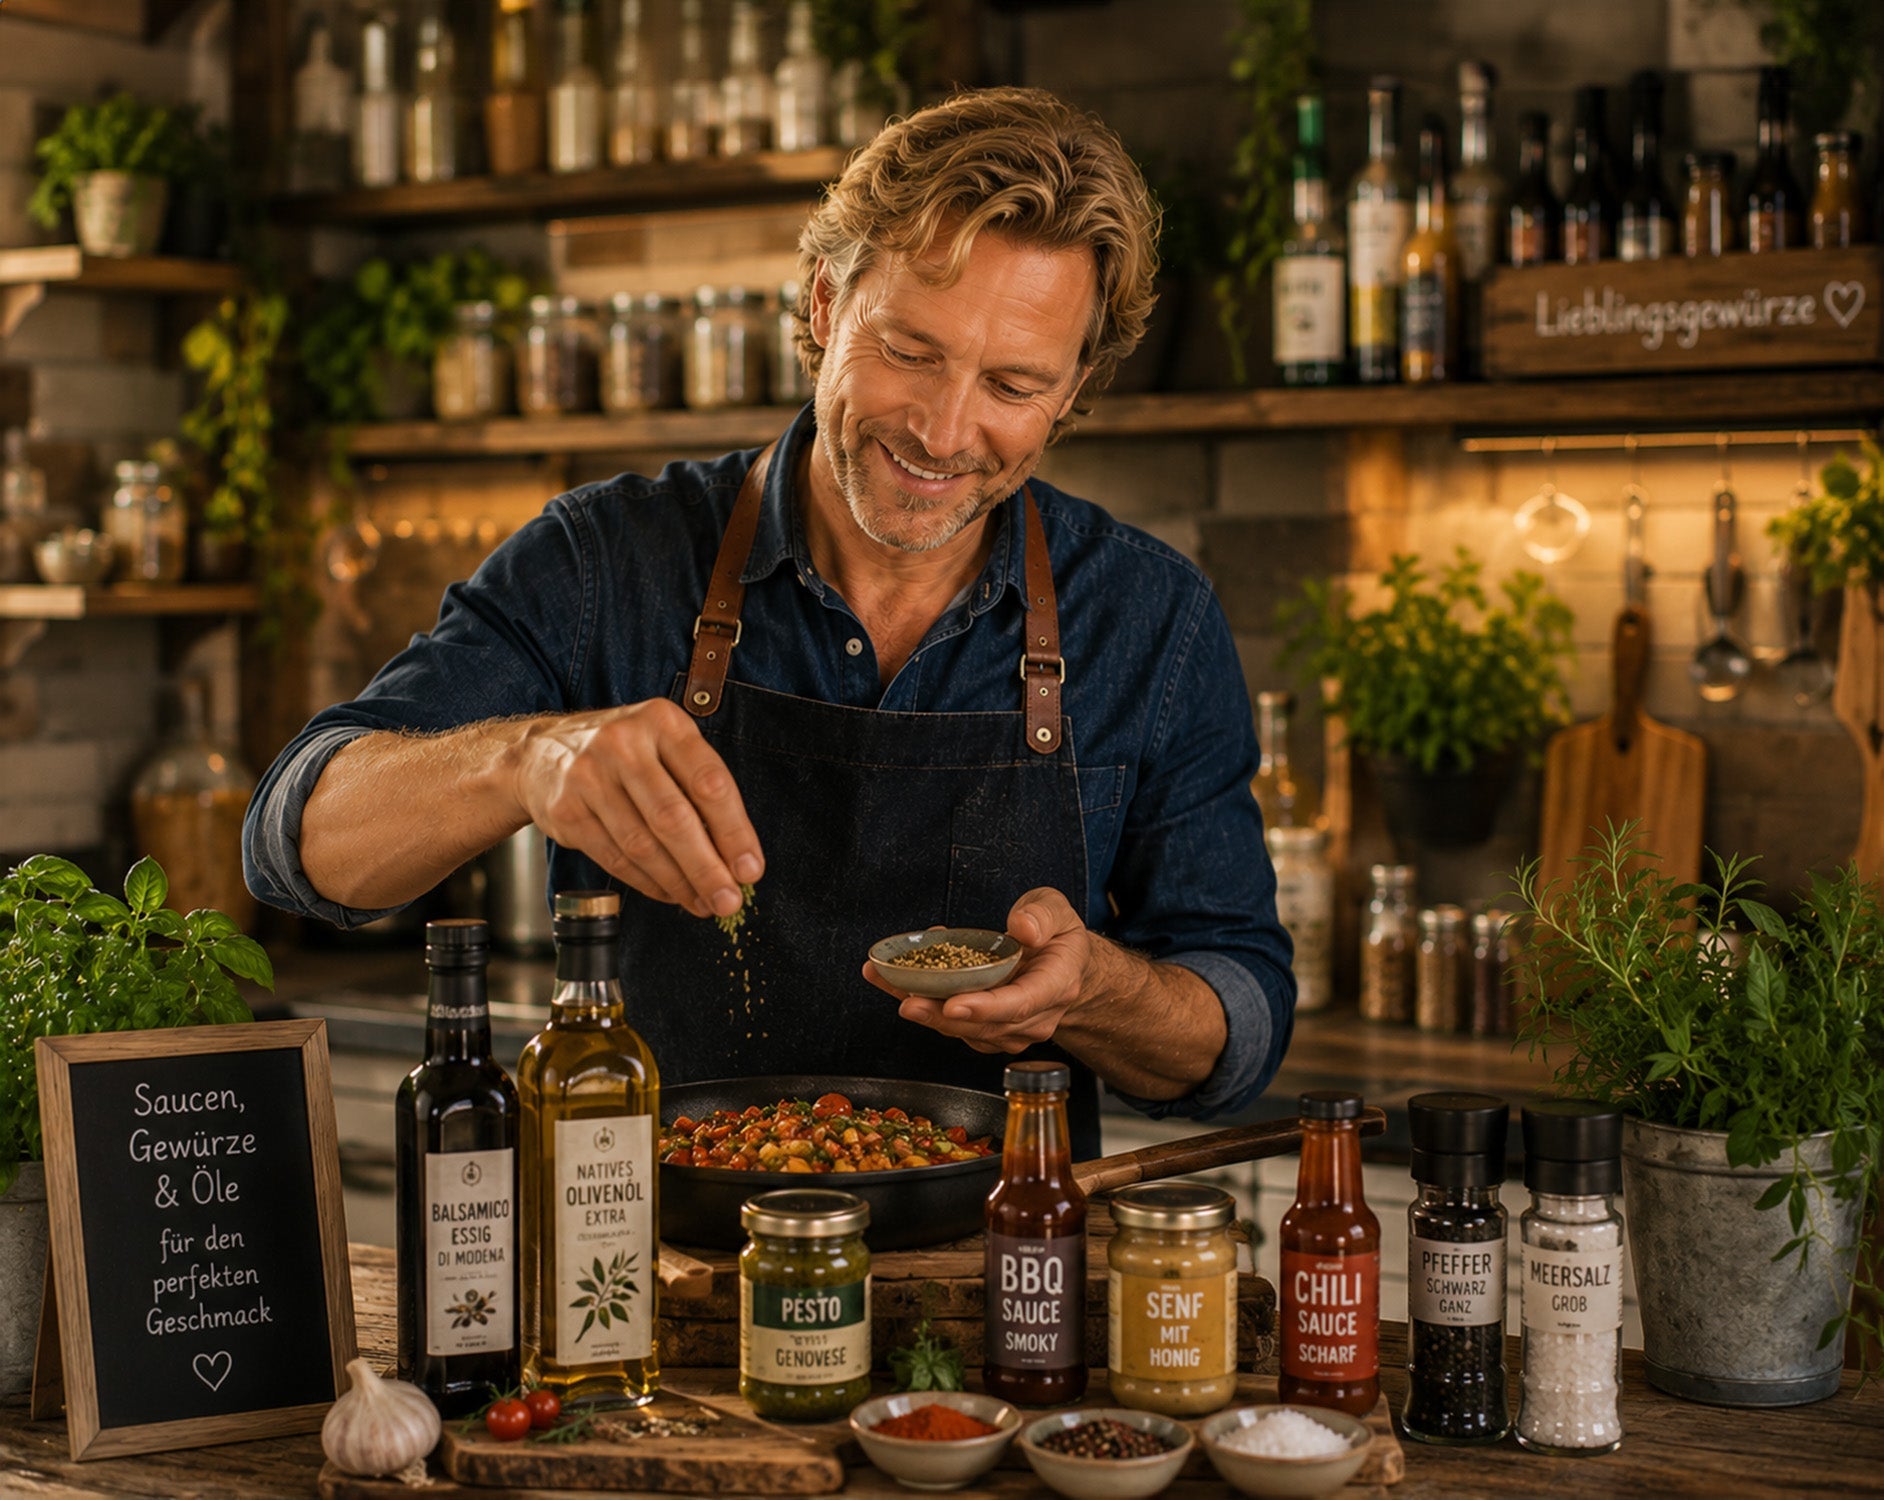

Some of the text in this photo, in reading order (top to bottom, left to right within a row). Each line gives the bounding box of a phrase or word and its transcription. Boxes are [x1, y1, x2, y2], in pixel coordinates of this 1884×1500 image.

[1535, 285, 1817, 350] Lieblingsgewürze
[133, 1083, 246, 1117] Saucen,
[129, 1129, 257, 1162] Gewürze
[577, 1161, 634, 1180] NATIVES
[154, 1165, 240, 1209] & Öle
[432, 1199, 510, 1222] BALSAMICO
[585, 1209, 626, 1226] EXTRA
[160, 1224, 245, 1264] für den
[451, 1225, 491, 1245] ESSIG
[438, 1246, 506, 1267] DI MODENA
[1422, 1251, 1492, 1275] PFEFFER
[153, 1262, 260, 1303] perfekten
[1001, 1253, 1064, 1295] BBQ
[1426, 1277, 1486, 1295] SCHWARZ
[1530, 1260, 1611, 1287] MEERSALZ
[1295, 1270, 1362, 1306] CHILI
[781, 1296, 842, 1323] PESTO
[1002, 1298, 1061, 1324] SAUCE
[1146, 1292, 1204, 1319] SENF
[1439, 1299, 1472, 1314] GANZ
[1552, 1294, 1588, 1312] GROB
[146, 1296, 273, 1336] Geschmack
[1298, 1309, 1357, 1336] SAUCE
[1005, 1331, 1058, 1352] SMOKY
[1160, 1325, 1190, 1344] MIT
[776, 1347, 846, 1368] GENOVESE
[1150, 1348, 1200, 1367] HONIG
[1299, 1343, 1357, 1364] SCHARF
